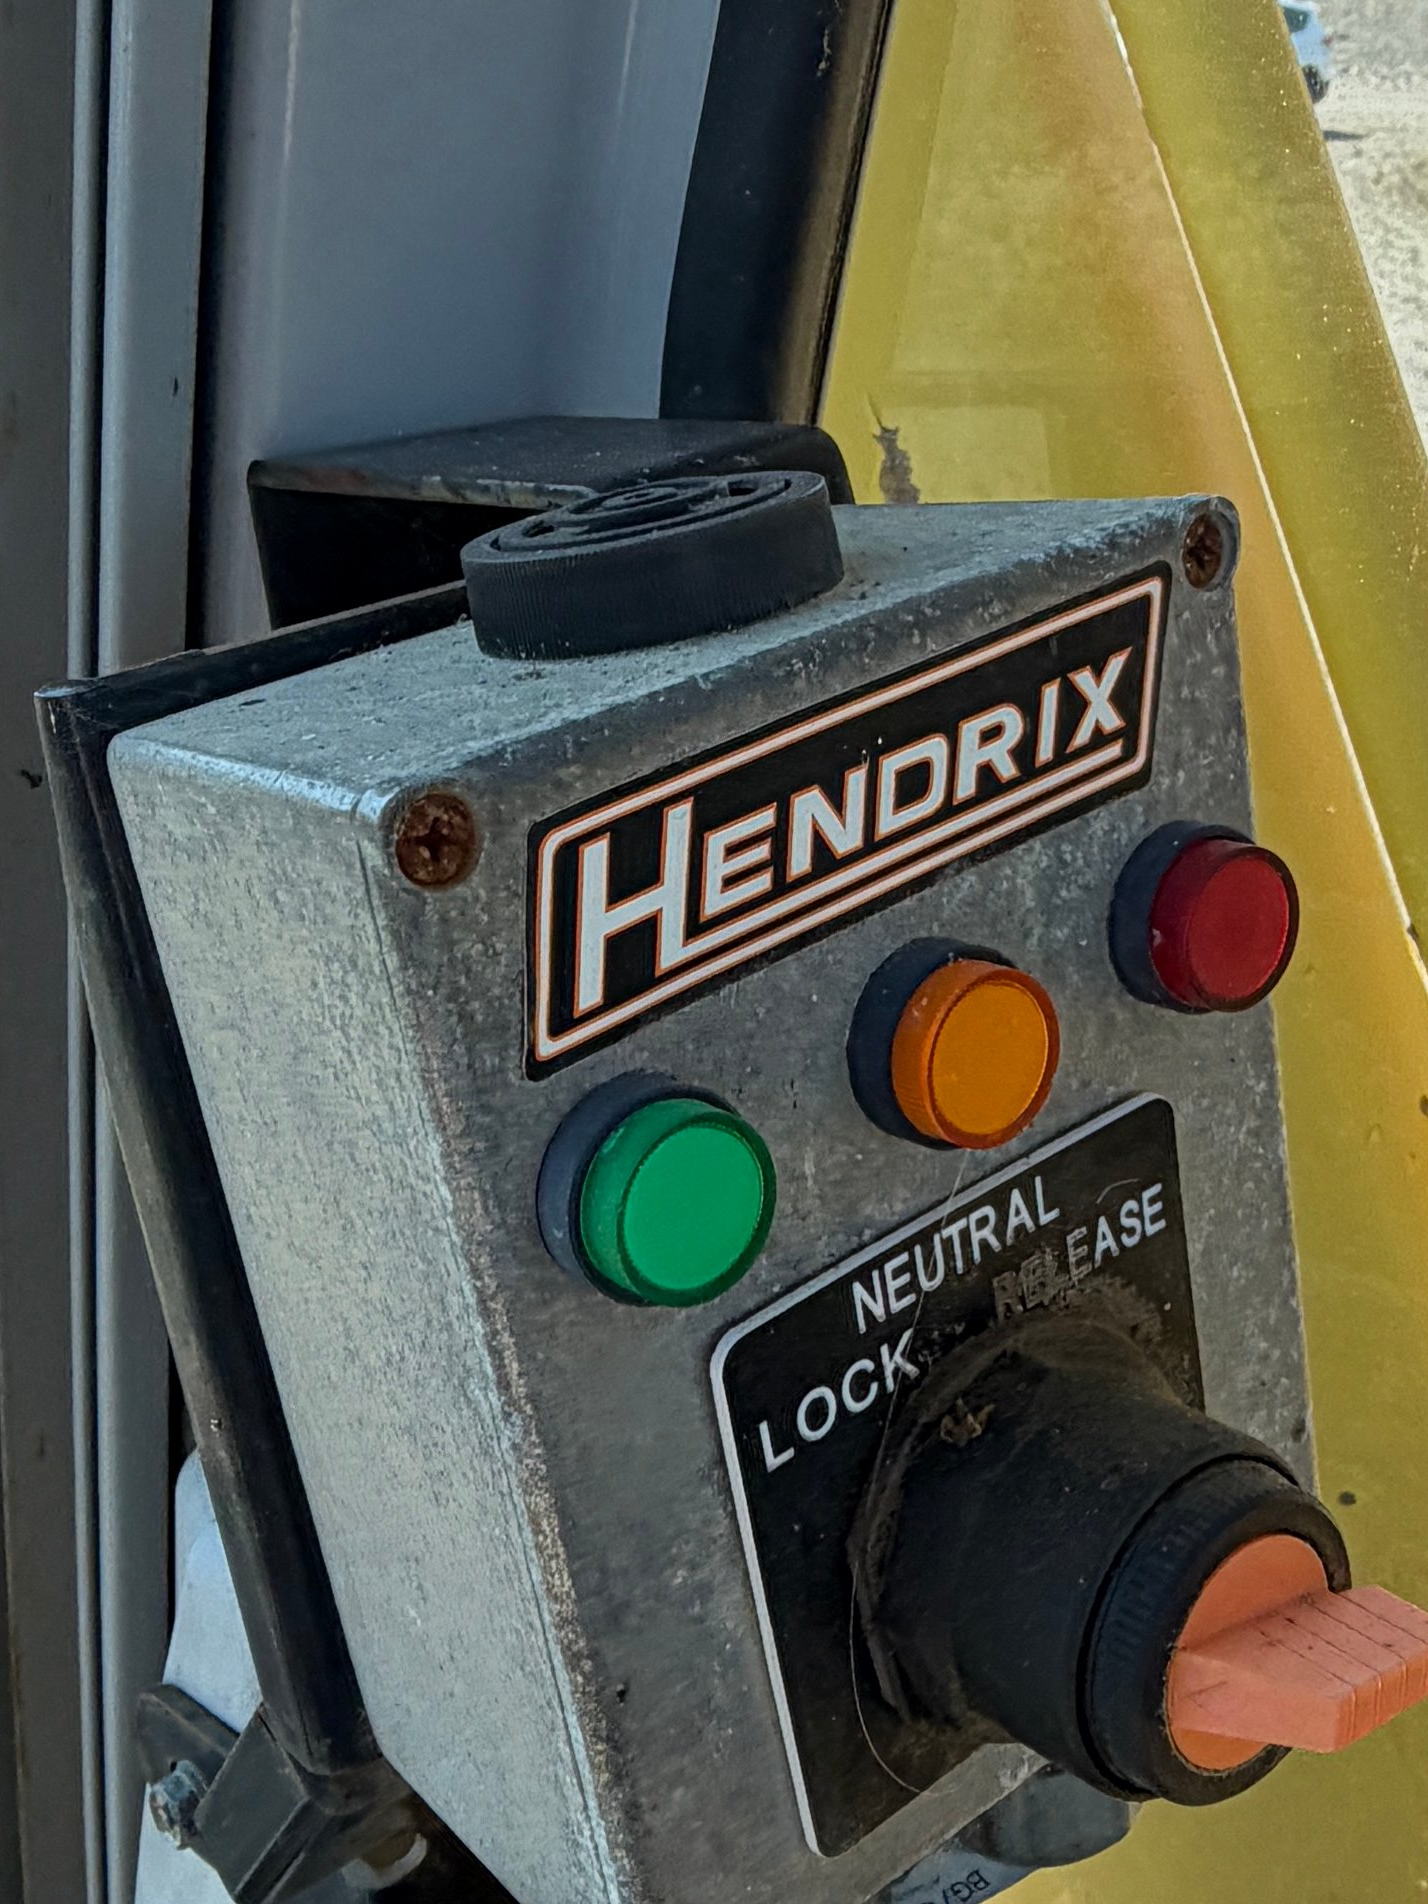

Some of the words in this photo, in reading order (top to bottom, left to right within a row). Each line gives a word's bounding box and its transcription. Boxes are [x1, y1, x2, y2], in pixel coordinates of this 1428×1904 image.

[574, 645, 1133, 1018] HENDRIX
[851, 1175, 1061, 1334] NEUTRAL
[758, 1327, 920, 1473] LOCK
